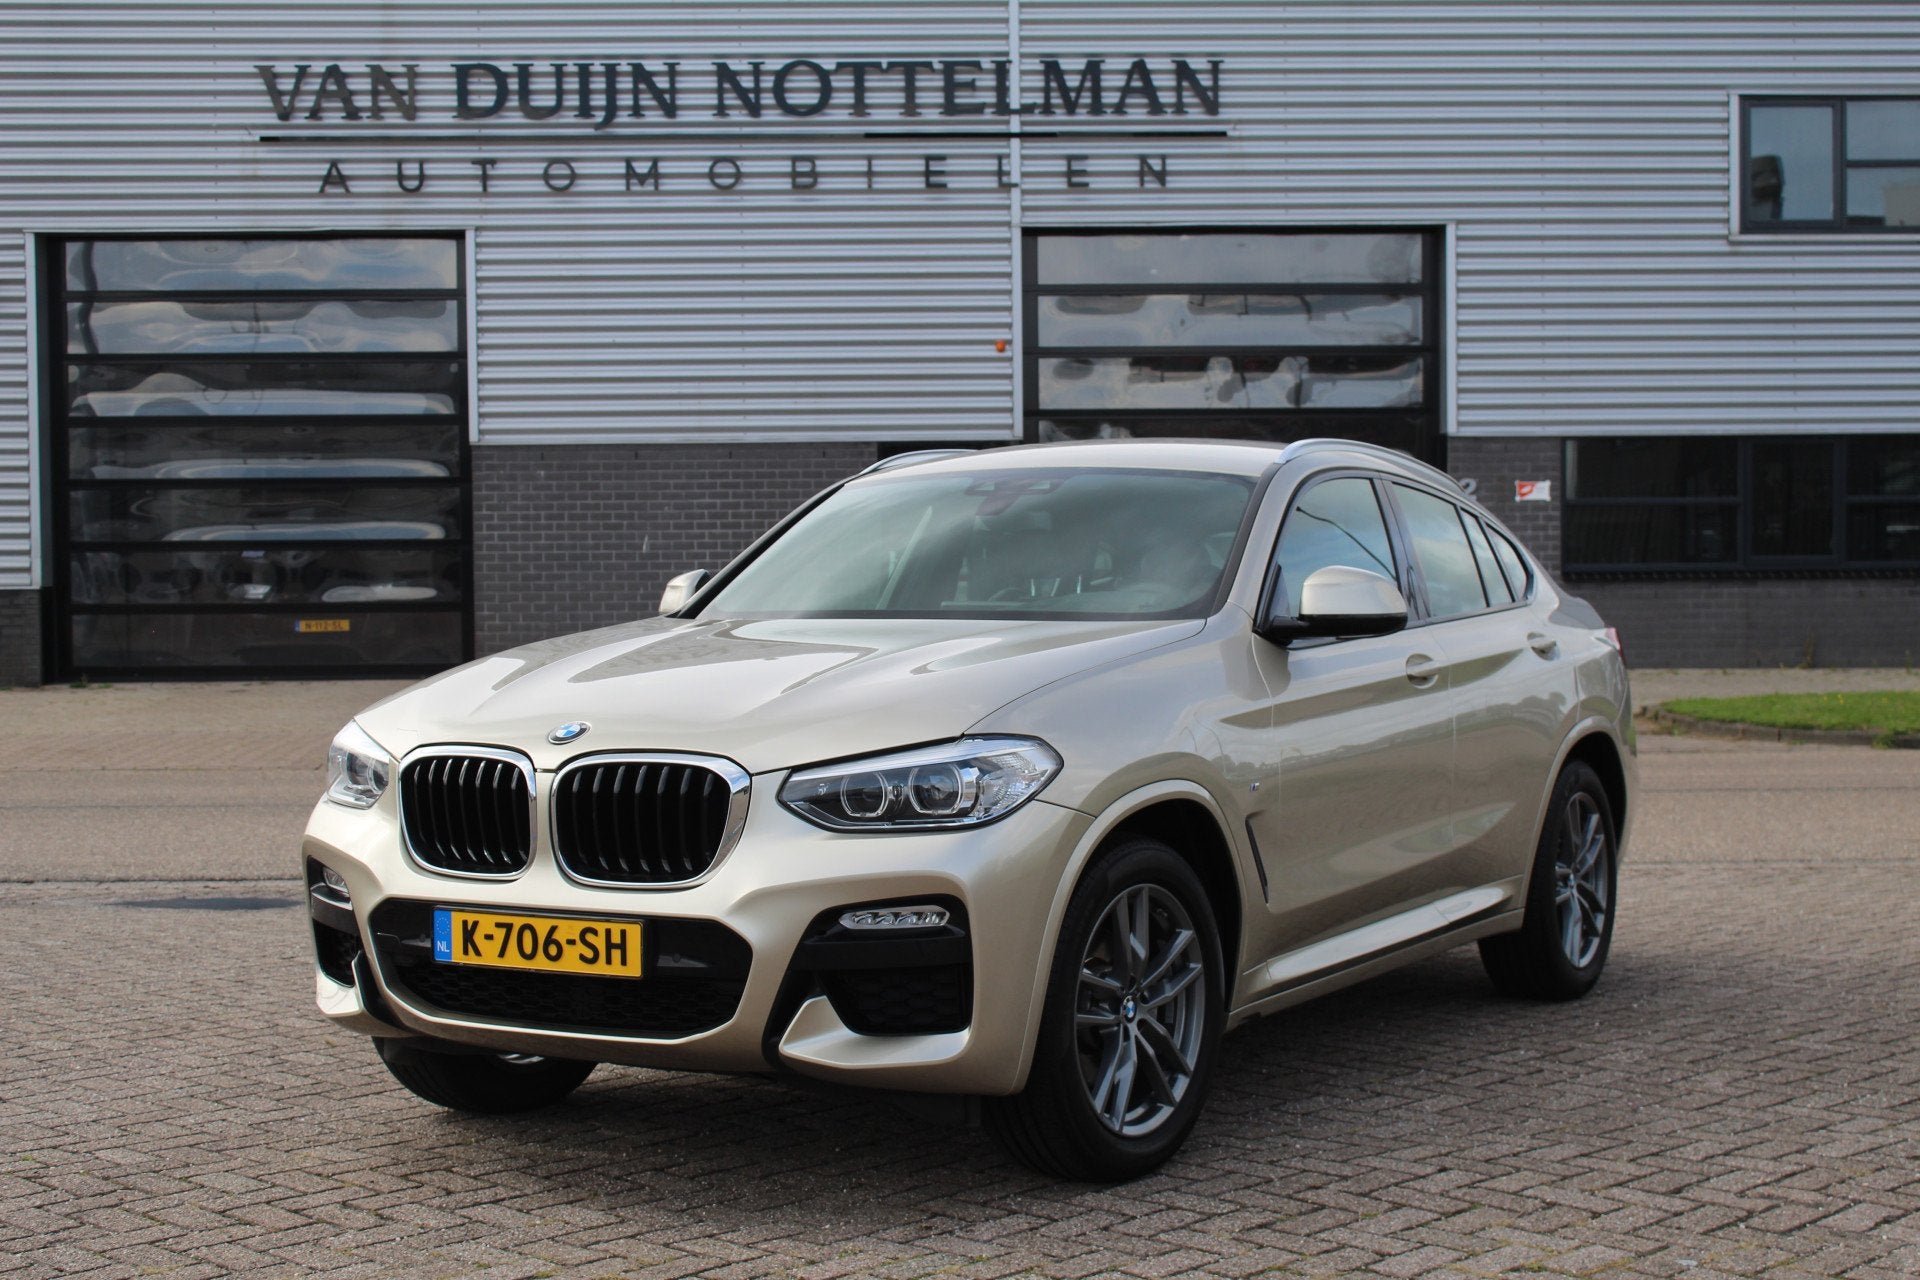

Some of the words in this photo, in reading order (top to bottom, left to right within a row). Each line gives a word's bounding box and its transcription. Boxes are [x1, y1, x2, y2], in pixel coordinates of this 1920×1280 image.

[253, 63, 420, 121] VAN
[450, 62, 681, 131] DUIJN
[711, 58, 1225, 118] NOTTELMAN
[318, 155, 1167, 193] AUTOMOBIELEN
[437, 941, 450, 953] NL
[461, 919, 628, 967] K-706-SH
